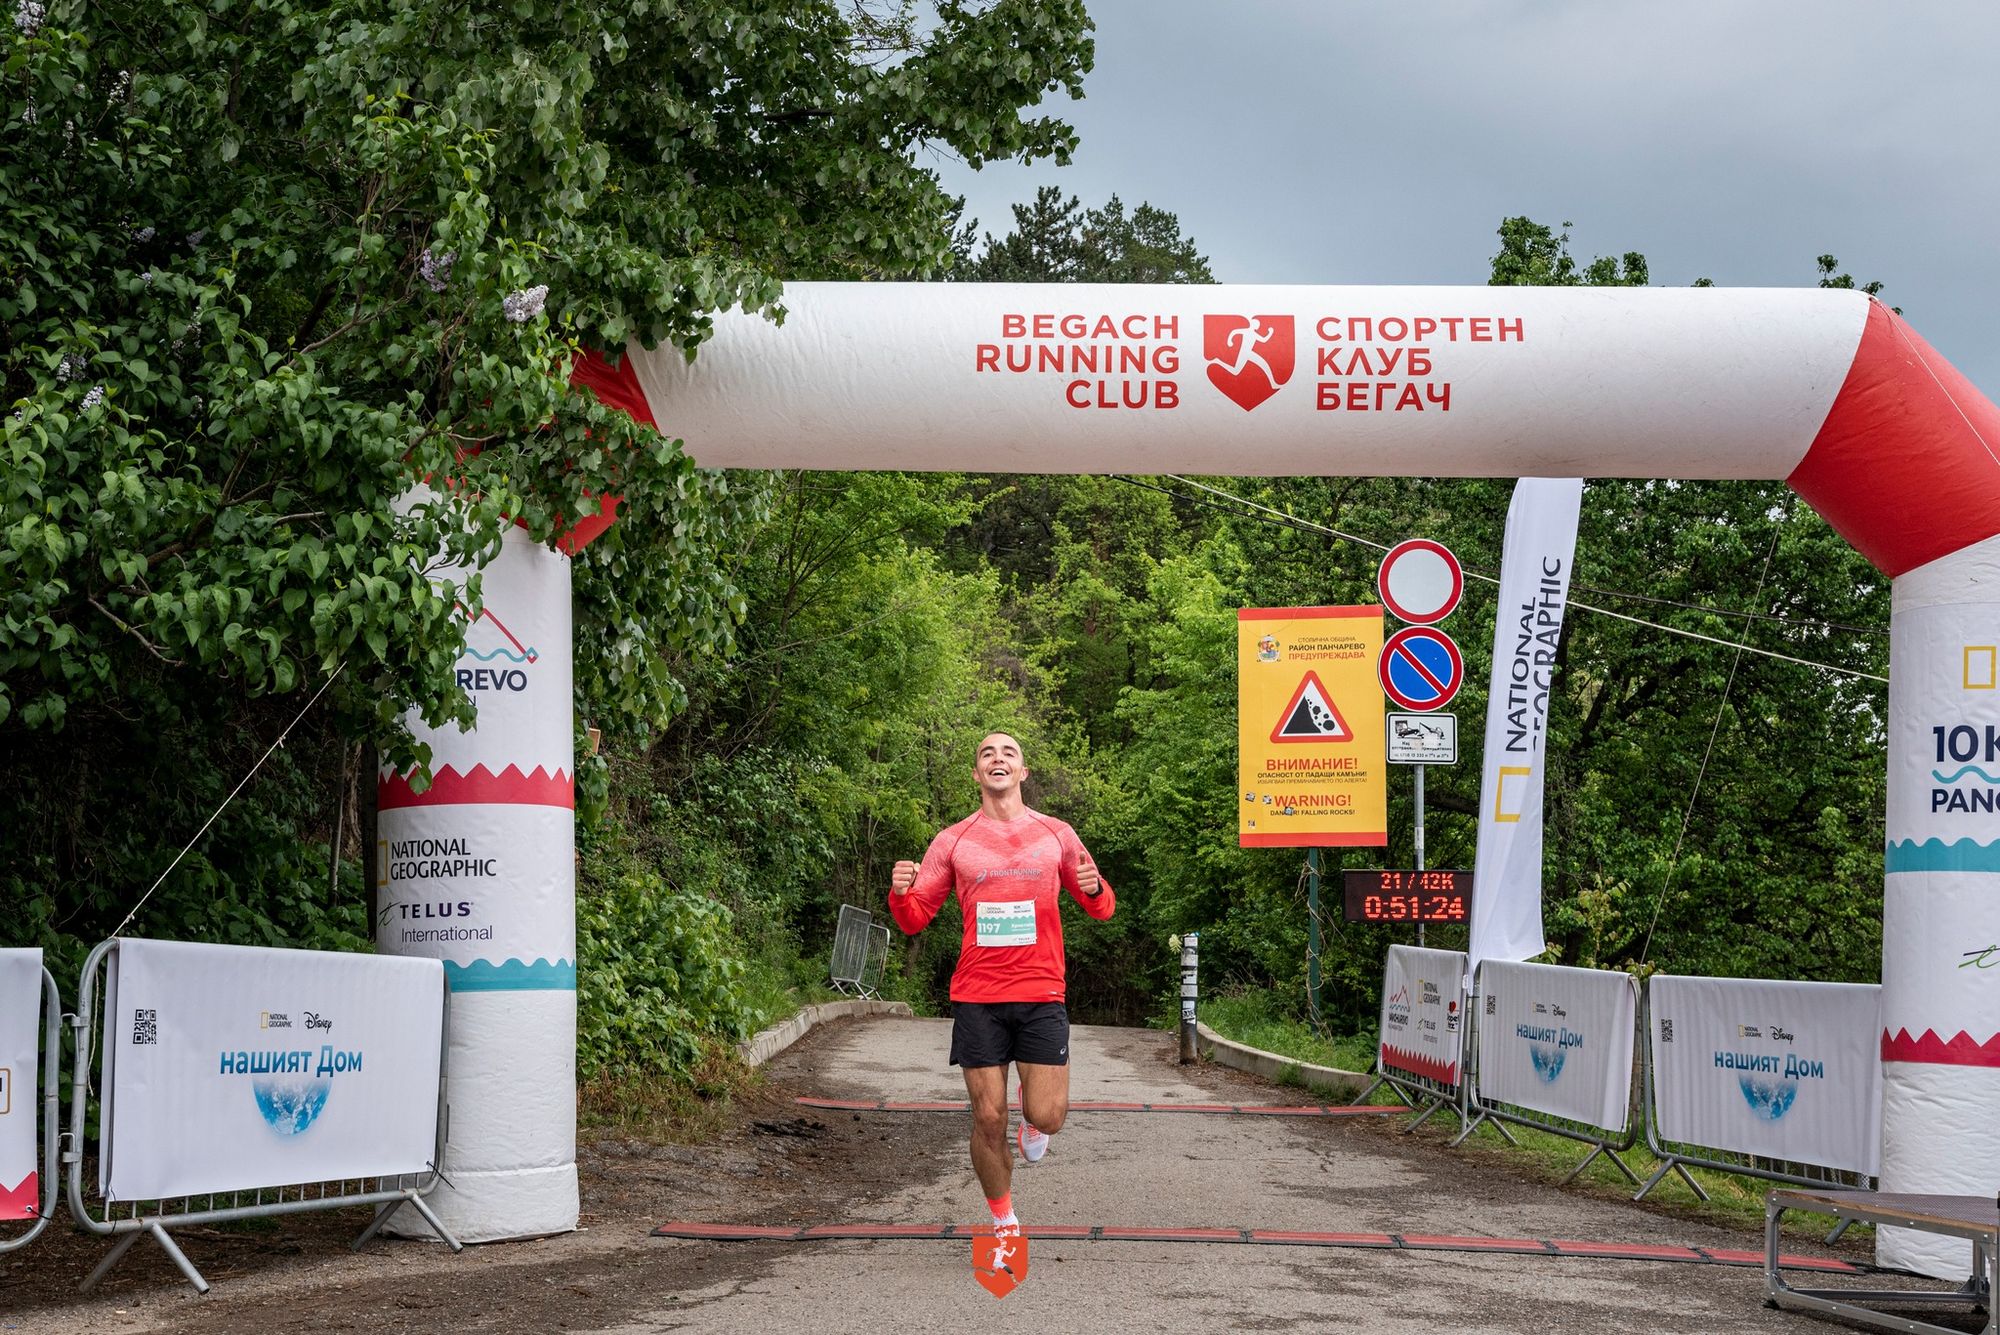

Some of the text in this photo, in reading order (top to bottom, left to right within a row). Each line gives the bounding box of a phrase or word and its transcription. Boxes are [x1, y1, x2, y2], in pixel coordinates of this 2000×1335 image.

[1003, 314, 1180, 339] BEGACH
[1316, 317, 1525, 342] СПОРТЕН
[976, 344, 1180, 373] RUNNING
[1317, 347, 1432, 376] КЛУБ
[1065, 380, 1180, 410] CLUB
[1317, 382, 1452, 412] БЕГАЧ
[1289, 643, 1366, 652] РАЙОН ПАНЧАРЕВО
[1289, 651, 1366, 661] ПРЕДУПРЕЖДАВА
[1505, 596, 1536, 752] NATIONAL
[1266, 758, 1358, 771] ВНИМАНИЕ!
[1274, 795, 1351, 807] WARNING!
[1932, 788, 2000, 813] PAN
[391, 838, 471, 859] NATIONAL
[390, 859, 497, 880] GEOGRAPHIC
[400, 902, 471, 919] TELUS
[1365, 896, 1465, 919] 0:51:24
[401, 925, 493, 943] International
[269, 1013, 288, 1021] NATIONAL
[1516, 1023, 1583, 1049] нашият Дом
[220, 1044, 363, 1078] нашият Дом
[1714, 1051, 1824, 1080] нашият Дом
